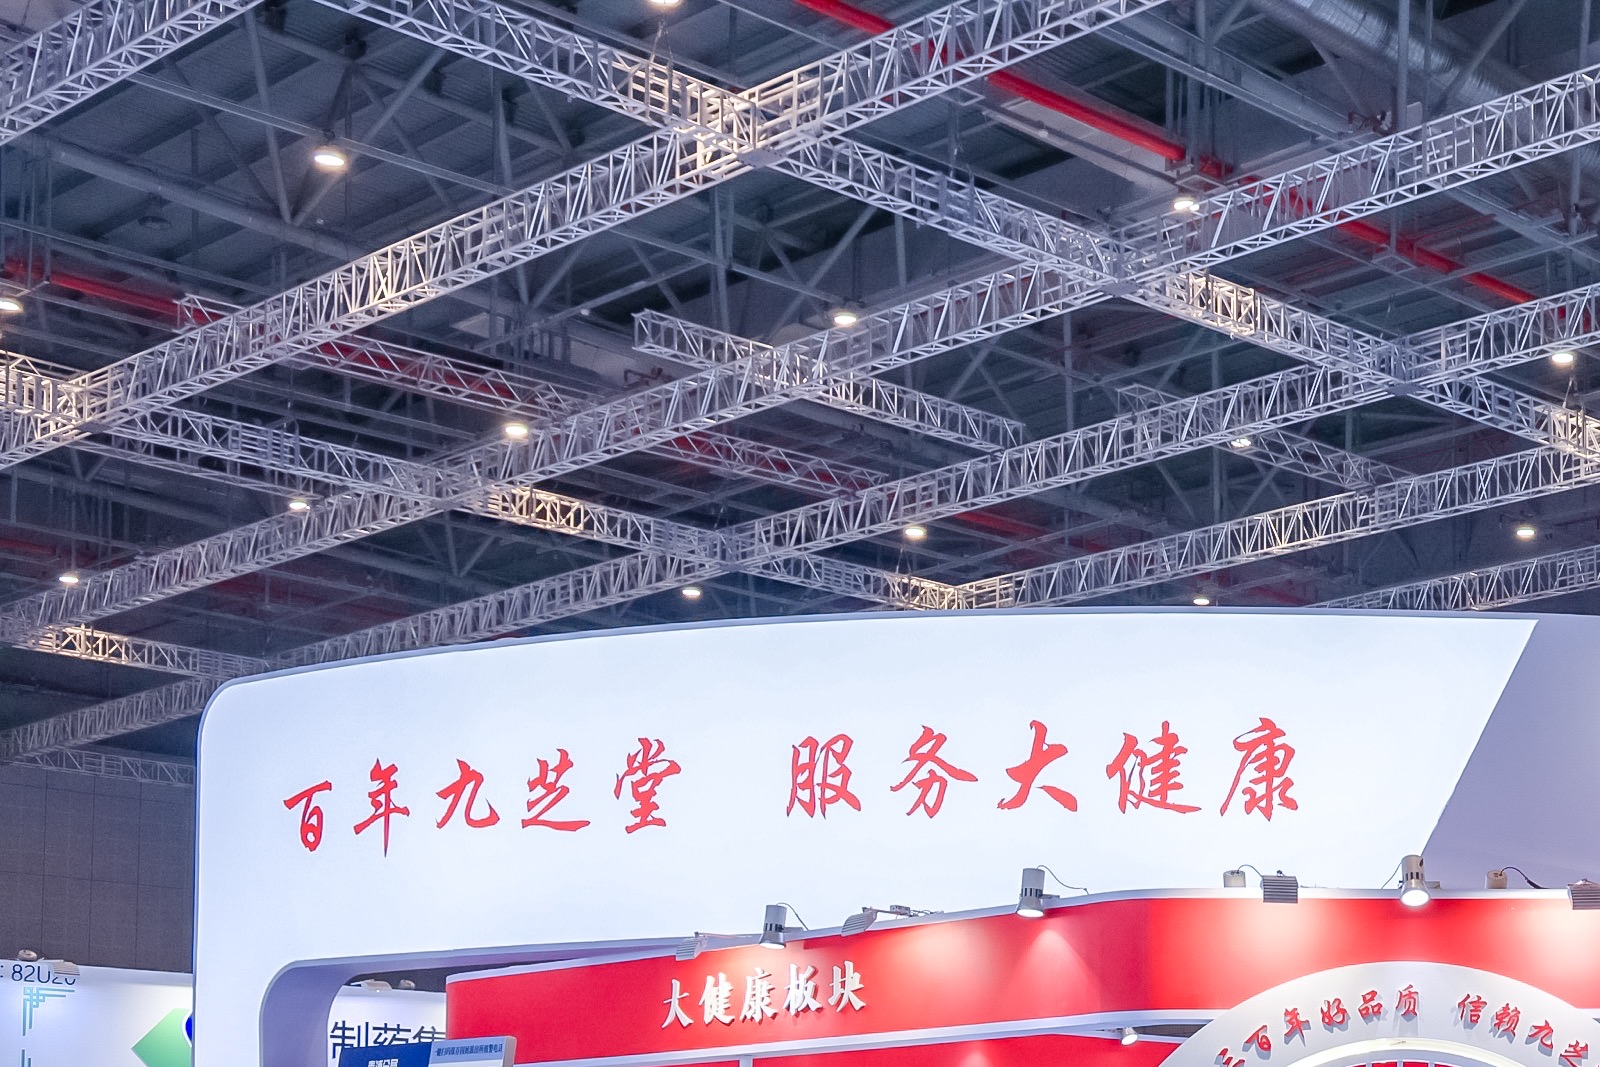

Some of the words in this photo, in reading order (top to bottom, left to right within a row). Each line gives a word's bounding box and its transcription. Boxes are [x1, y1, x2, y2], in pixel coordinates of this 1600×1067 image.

[283, 737, 682, 857] 百年九芝堂
[786, 717, 1299, 821] 服务大健康
[661, 960, 867, 1029] 大健康板块
